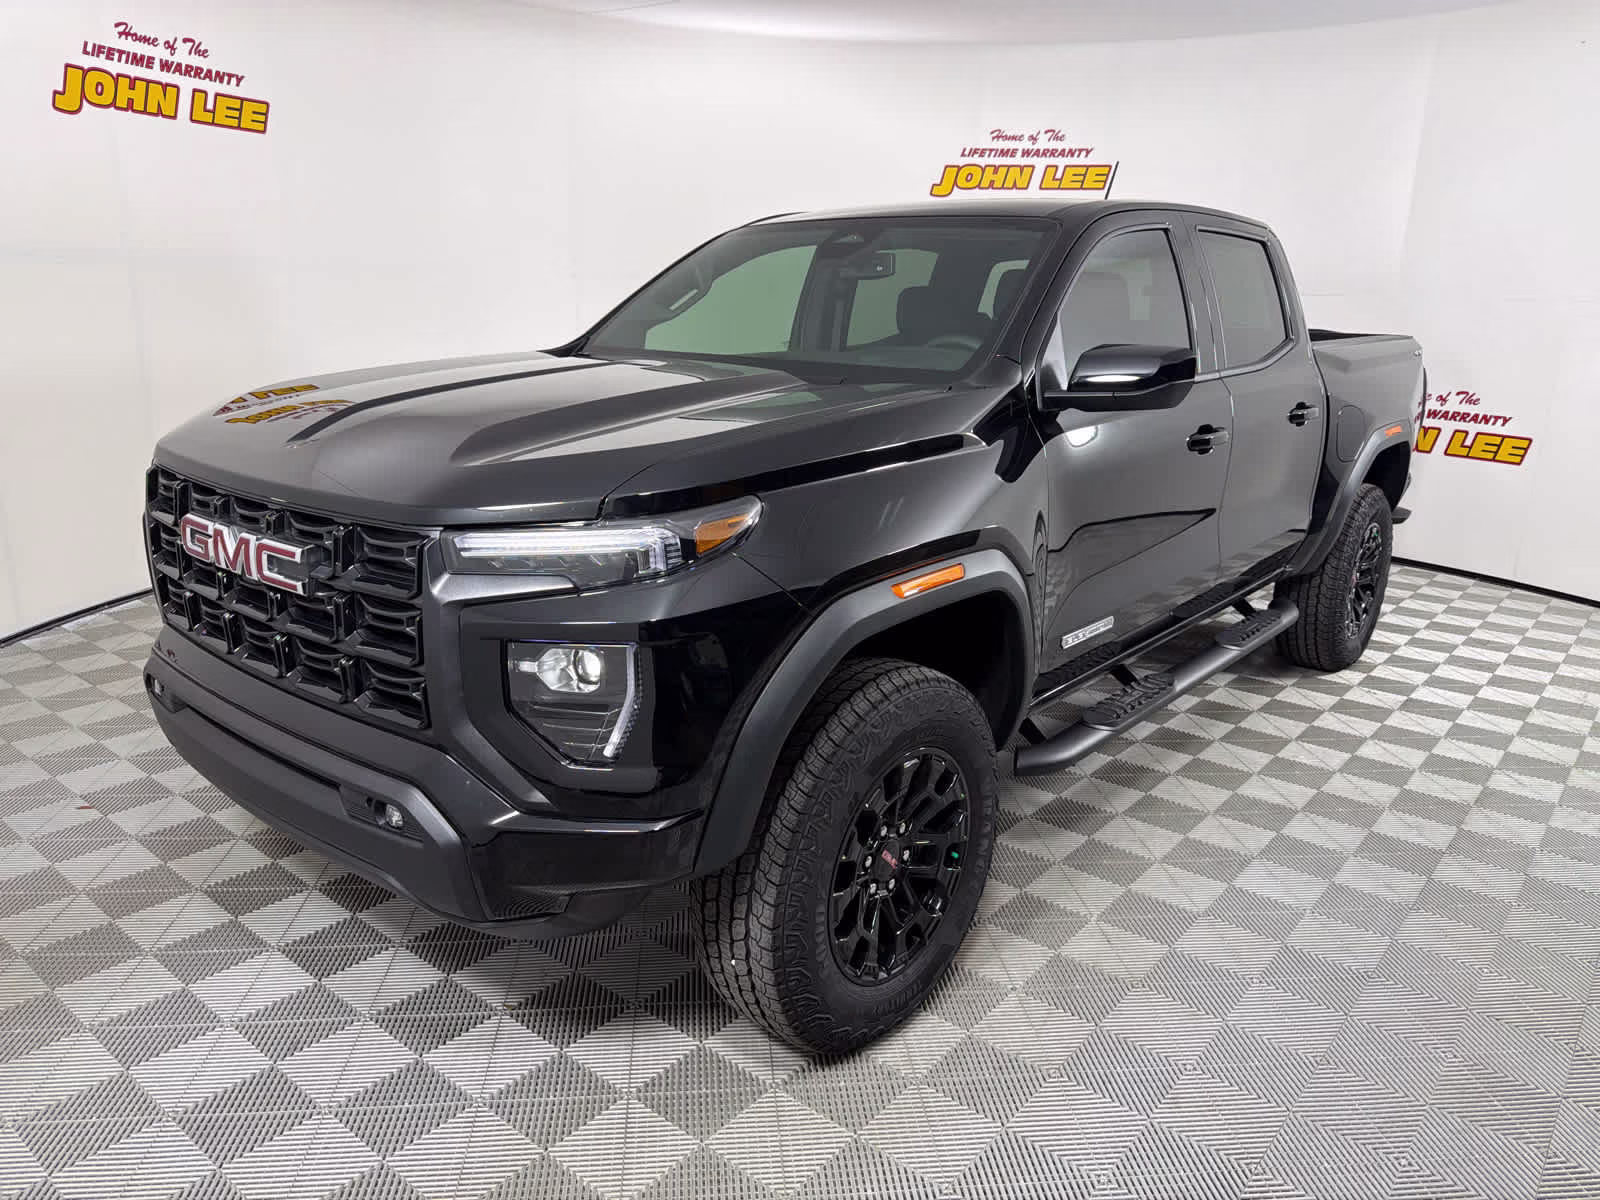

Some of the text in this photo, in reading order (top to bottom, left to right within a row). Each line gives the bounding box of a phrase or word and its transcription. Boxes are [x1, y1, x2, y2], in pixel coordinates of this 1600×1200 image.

[114, 21, 210, 58] Home of The
[82, 40, 245, 88] LIFETIME WARRANTY
[52, 63, 270, 134] JOHN LEE
[960, 148, 1093, 158] LIFETIME WARRANTY
[989, 129, 1066, 145] Home of The
[930, 163, 1112, 197] JOHN LEE
[1435, 391, 1452, 407] of
[1456, 390, 1481, 406] The
[1426, 408, 1512, 427] WARRANTY
[1444, 429, 1533, 466] LEE
[181, 513, 305, 596] GMC
